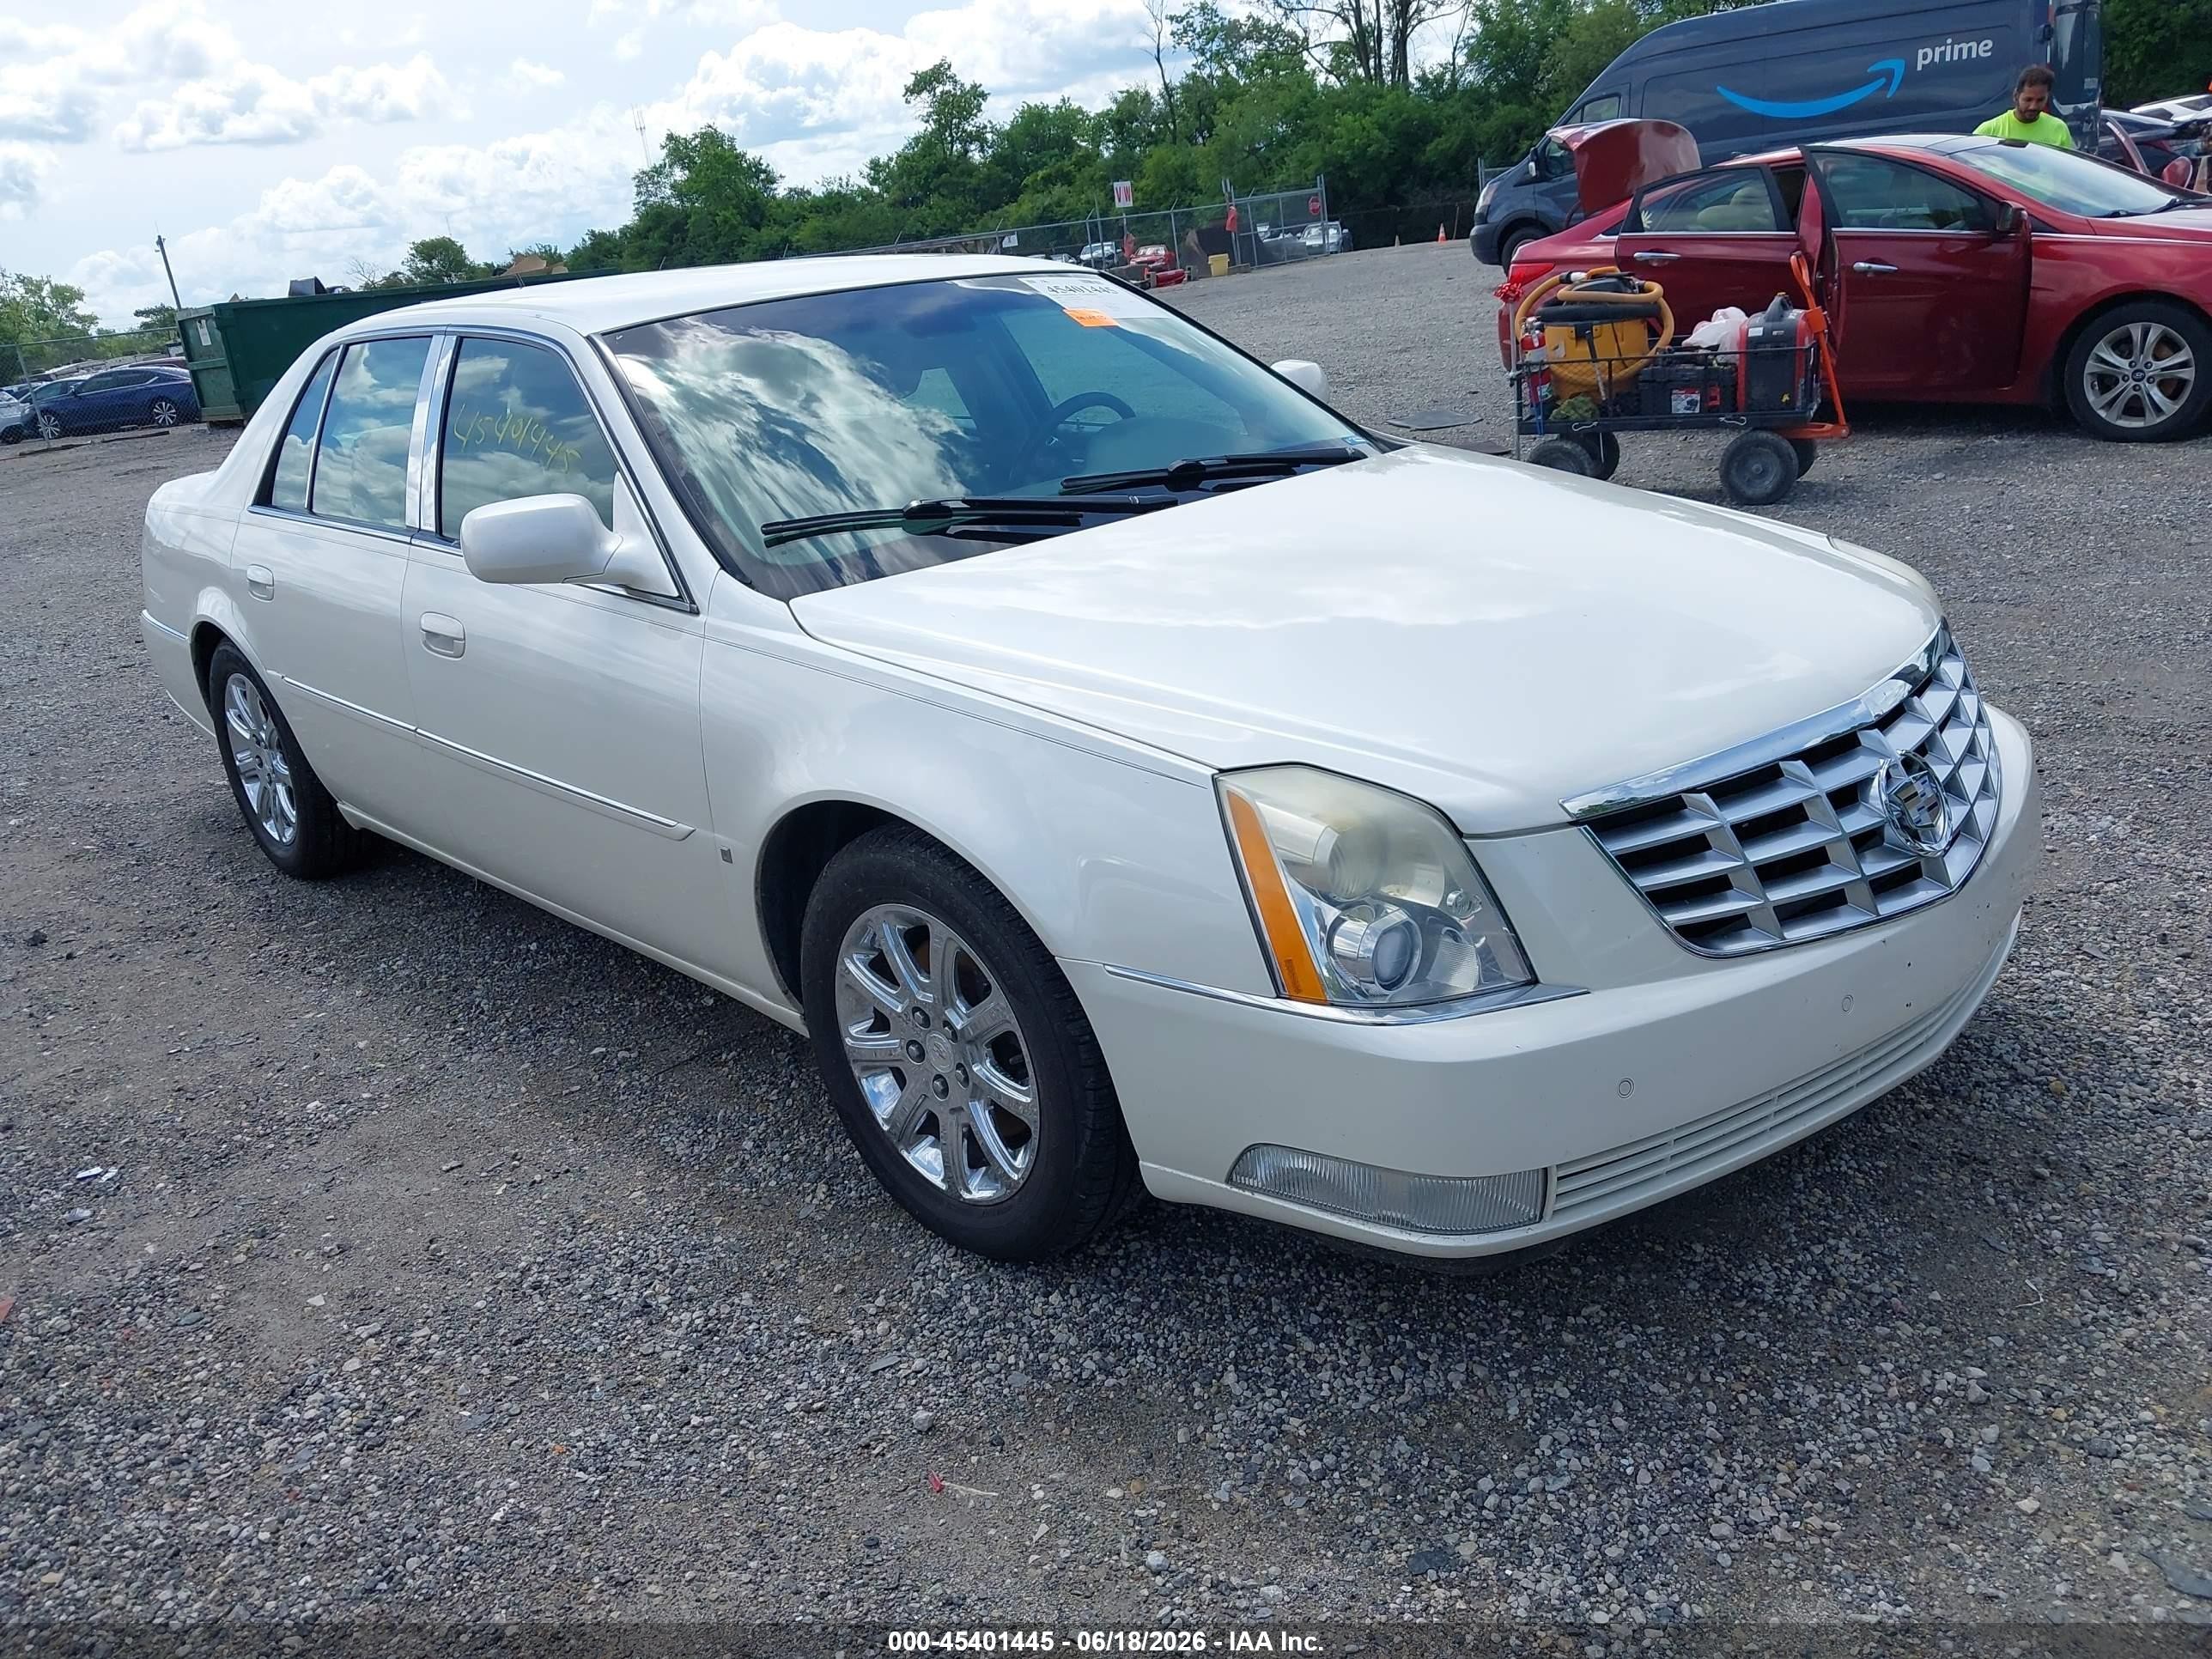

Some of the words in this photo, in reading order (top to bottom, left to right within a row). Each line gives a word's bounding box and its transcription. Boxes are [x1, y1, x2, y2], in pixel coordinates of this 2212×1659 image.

[1917, 38, 1993, 71] prime
[1047, 285, 1118, 295] 45401445
[454, 404, 581, 473] 45401445
